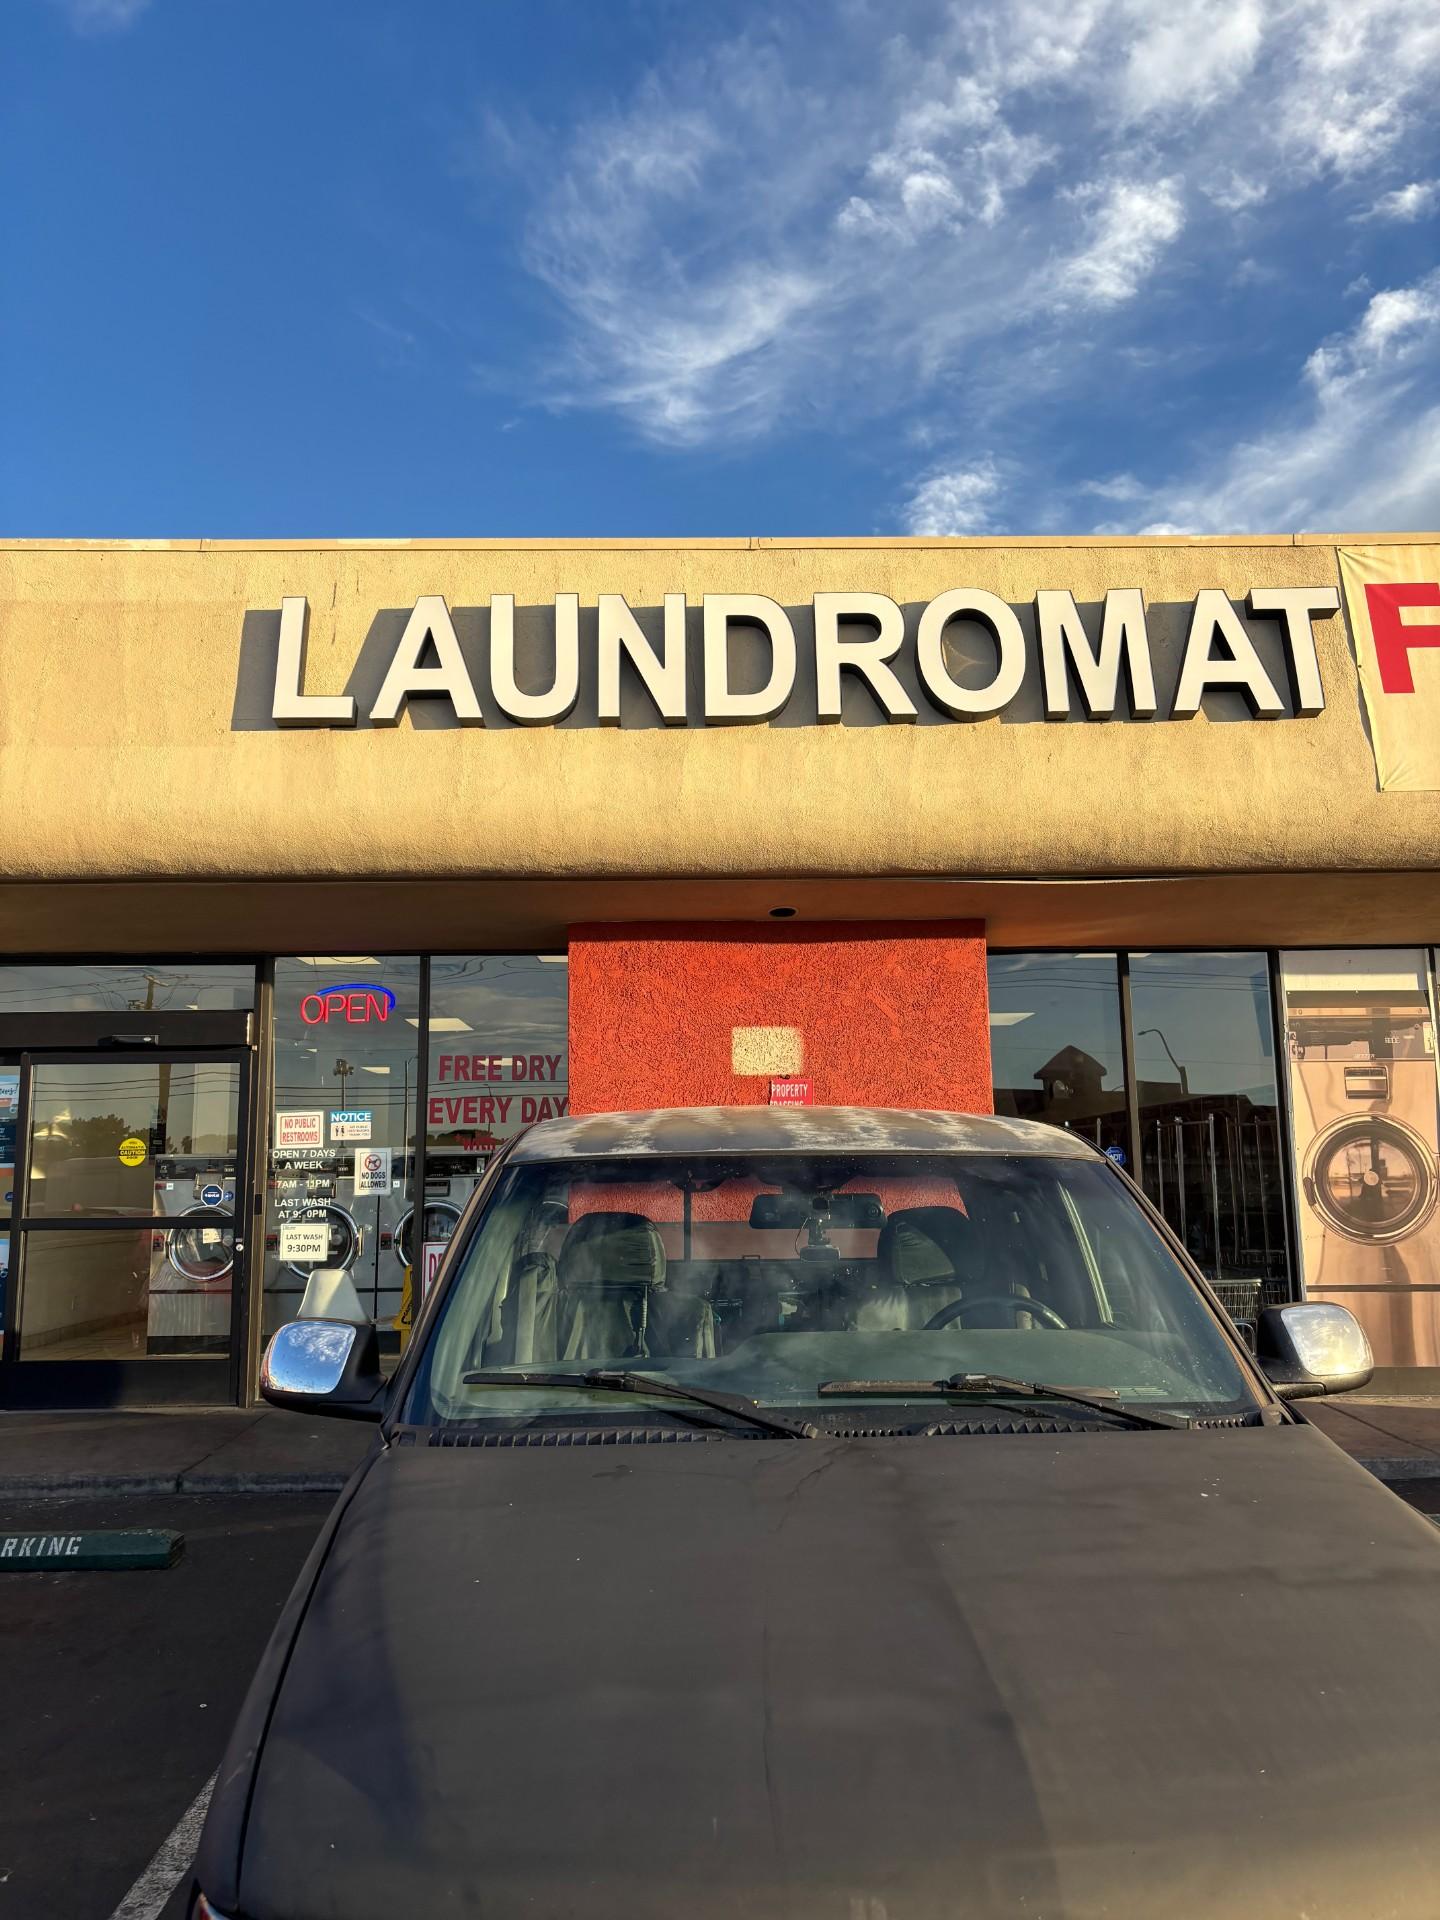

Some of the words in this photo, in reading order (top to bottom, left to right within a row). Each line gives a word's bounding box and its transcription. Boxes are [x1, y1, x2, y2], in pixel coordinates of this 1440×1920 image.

[271, 587, 1339, 724] LAUNDROMAT
[301, 993, 389, 1024] OPEN
[438, 1055, 503, 1081] FREE
[511, 1055, 562, 1081] DRY
[771, 1083, 808, 1097] PROPERTY
[429, 1097, 513, 1124] EVERY
[521, 1097, 568, 1124] DAY
[331, 1112, 372, 1122] NOTICE
[284, 1118, 293, 1129] NO
[294, 1118, 316, 1129] PUBLIC
[282, 1131, 318, 1142] RESTROOMS
[272, 1150, 300, 1158] OPEN
[302, 1150, 307, 1158] 7
[310, 1149, 336, 1158] DAYS
[284, 1161, 292, 1170] A
[294, 1161, 323, 1169] WEEK
[361, 1171, 370, 1179] NO
[370, 1171, 386, 1179] DOGS
[276, 1180, 297, 1188] 7AM
[360, 1181, 387, 1189] ALLOWED
[274, 1198, 300, 1207] LAST
[302, 1197, 331, 1206] WASH
[278, 1210, 291, 1218] AT
[287, 1244, 321, 1253] 9:30PM
